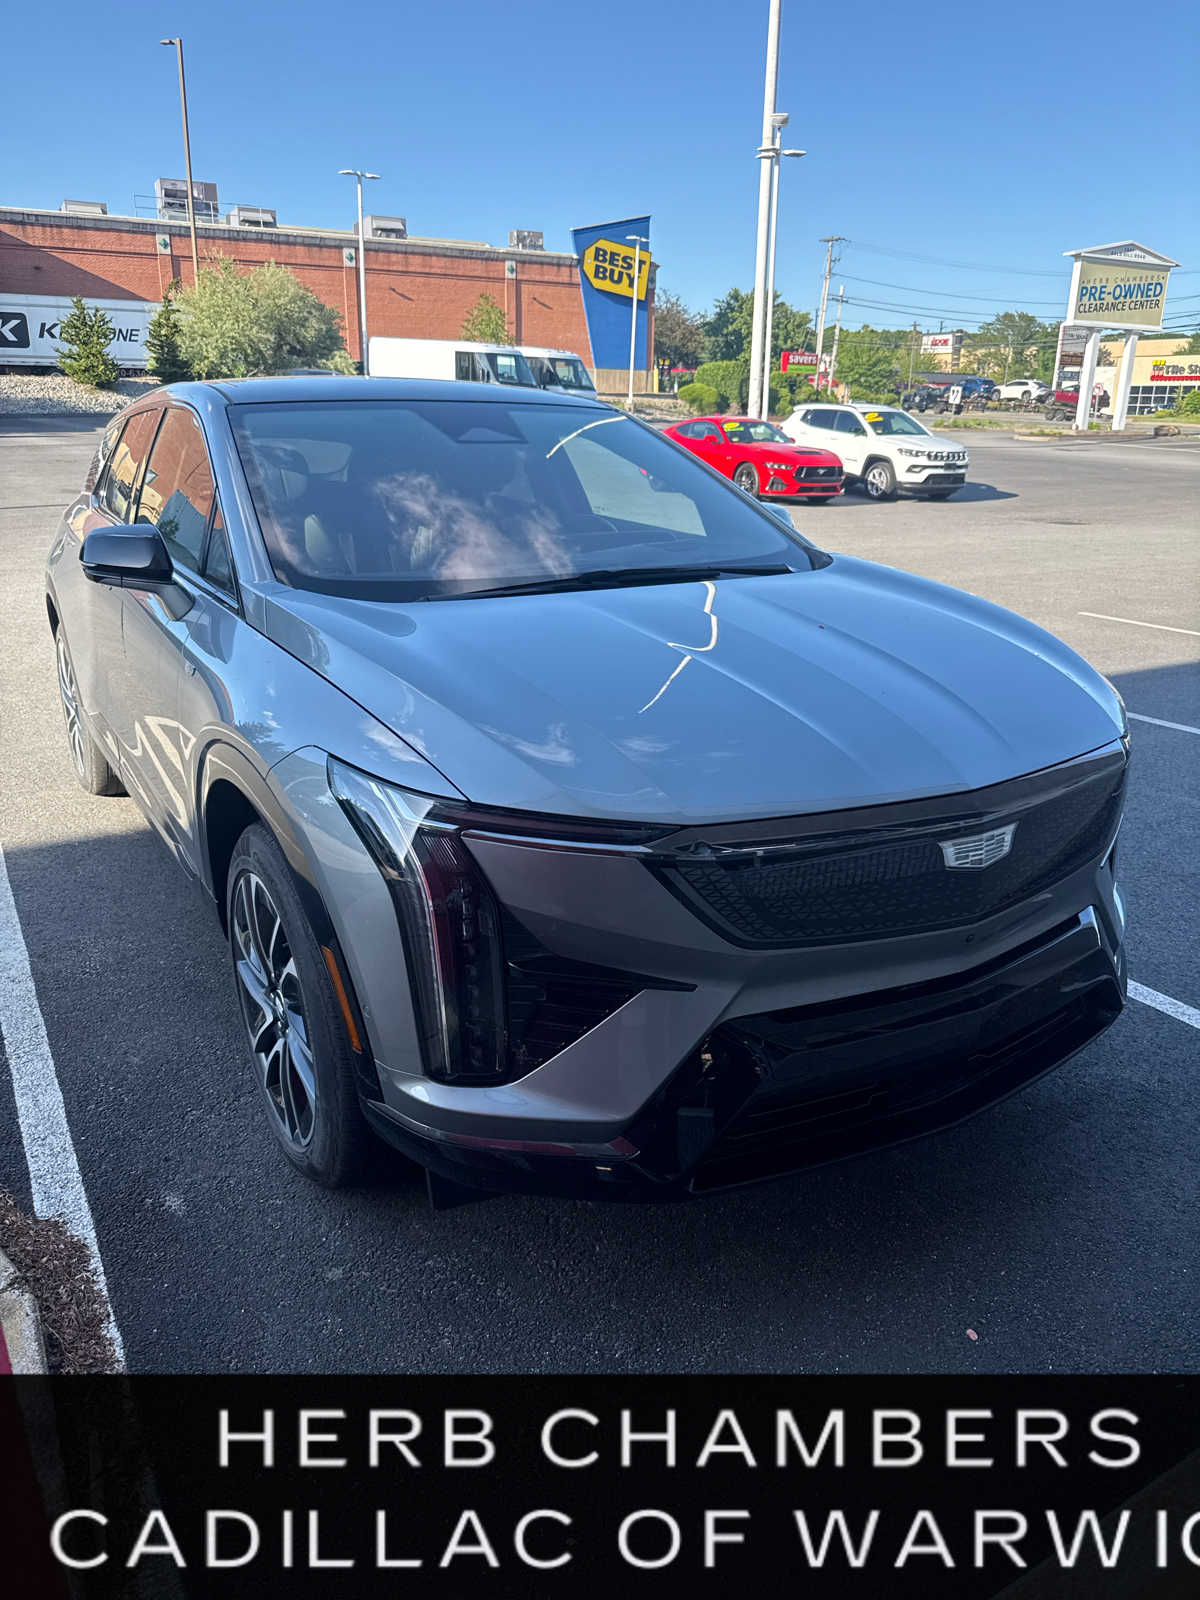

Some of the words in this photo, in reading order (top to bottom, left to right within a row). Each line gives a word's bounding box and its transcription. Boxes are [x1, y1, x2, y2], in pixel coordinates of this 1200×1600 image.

[593, 247, 647, 274] BEST
[593, 264, 640, 288] BUY
[1079, 282, 1163, 302] PRE-OWNED
[1078, 300, 1126, 314] CLEARANCE
[1128, 299, 1160, 311] CENTER
[788, 355, 817, 365] savers
